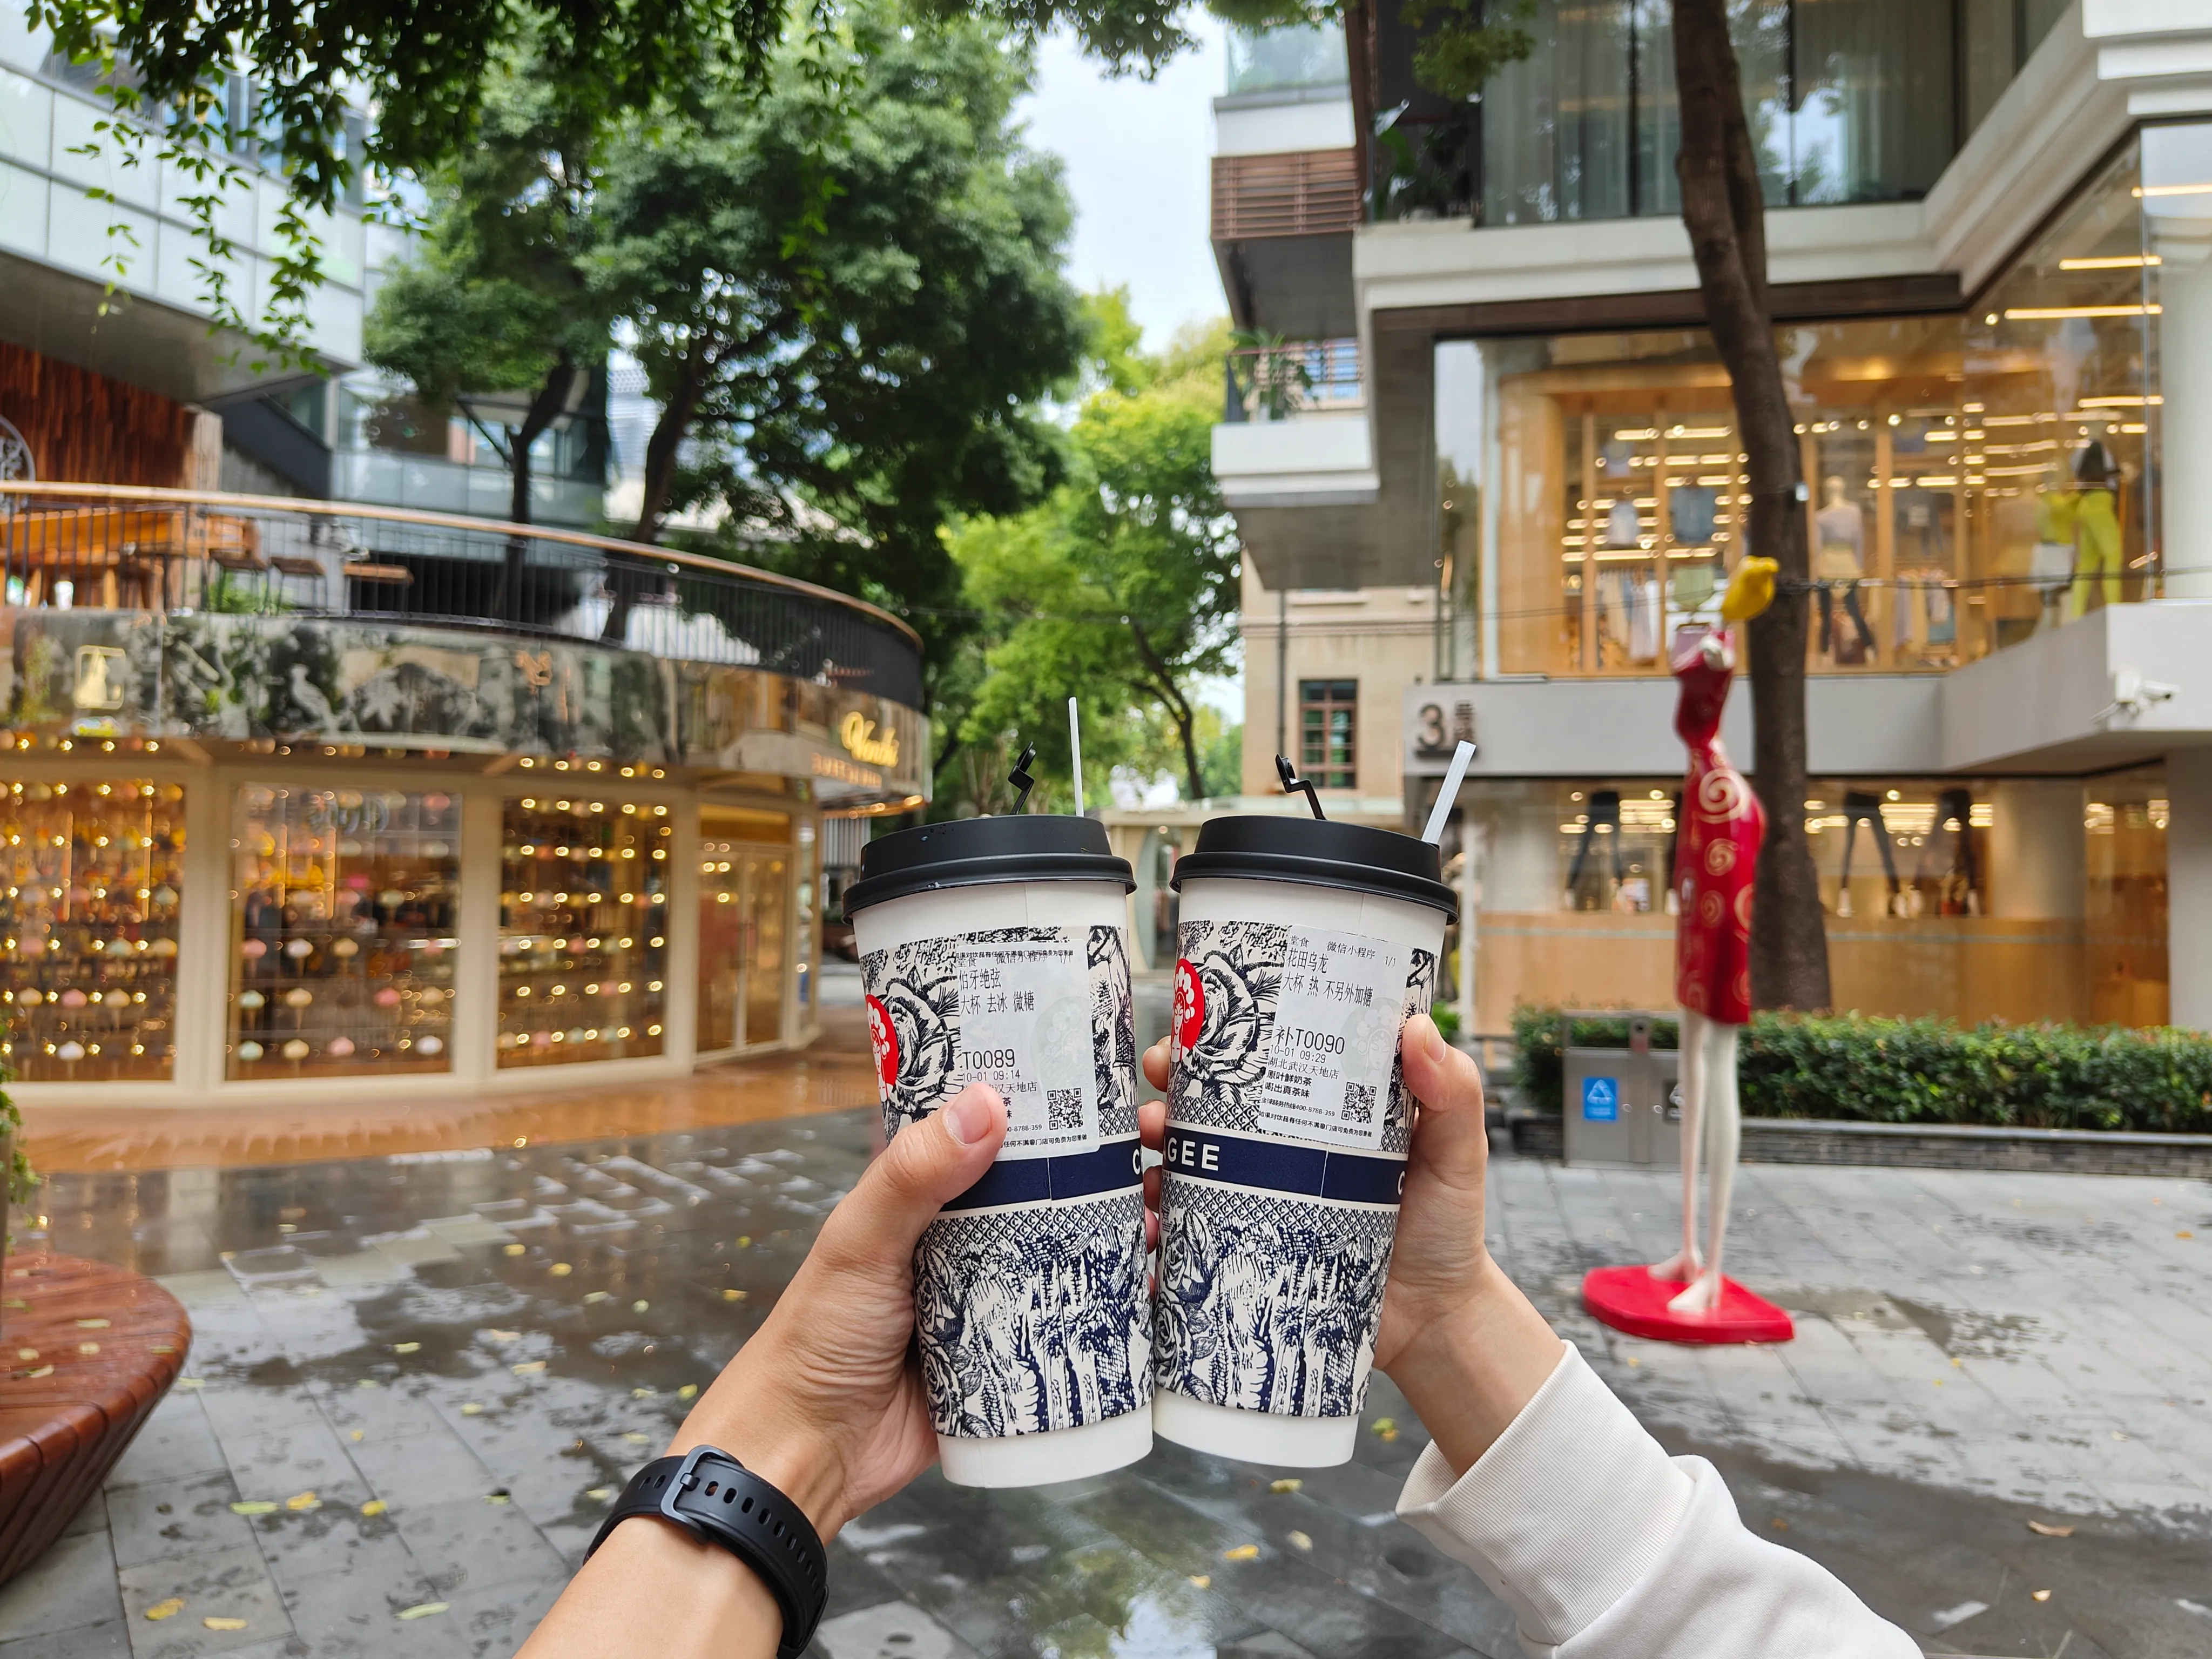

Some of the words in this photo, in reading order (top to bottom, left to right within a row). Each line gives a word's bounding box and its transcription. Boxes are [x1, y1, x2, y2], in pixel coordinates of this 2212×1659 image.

[1417, 704, 1445, 746] 3
[1286, 948, 1329, 973] 花田乌龙
[1290, 936, 1310, 948] 堂食
[1327, 941, 1376, 960] 微信小程序
[1385, 956, 1397, 967] 1/1
[959, 967, 1001, 991] 伯牙绝弦
[1281, 971, 1305, 994] 大杯
[1307, 975, 1319, 997] 热
[1323, 980, 1373, 1008] 不另外加糖
[960, 994, 981, 1016] 大杯
[986, 992, 1008, 1013] 去冰
[1013, 989, 1035, 1013] 微糖
[962, 1049, 1015, 1070] T0089
[1270, 1044, 1294, 1057] 10-01
[1300, 1050, 1326, 1063] 09:29
[963, 1071, 987, 1082] 10-01
[993, 1069, 1020, 1081] 09:14
[1266, 1069, 1312, 1087] 原叶鲜奶茶
[1268, 1056, 1339, 1080] 湖北武汉天地店
